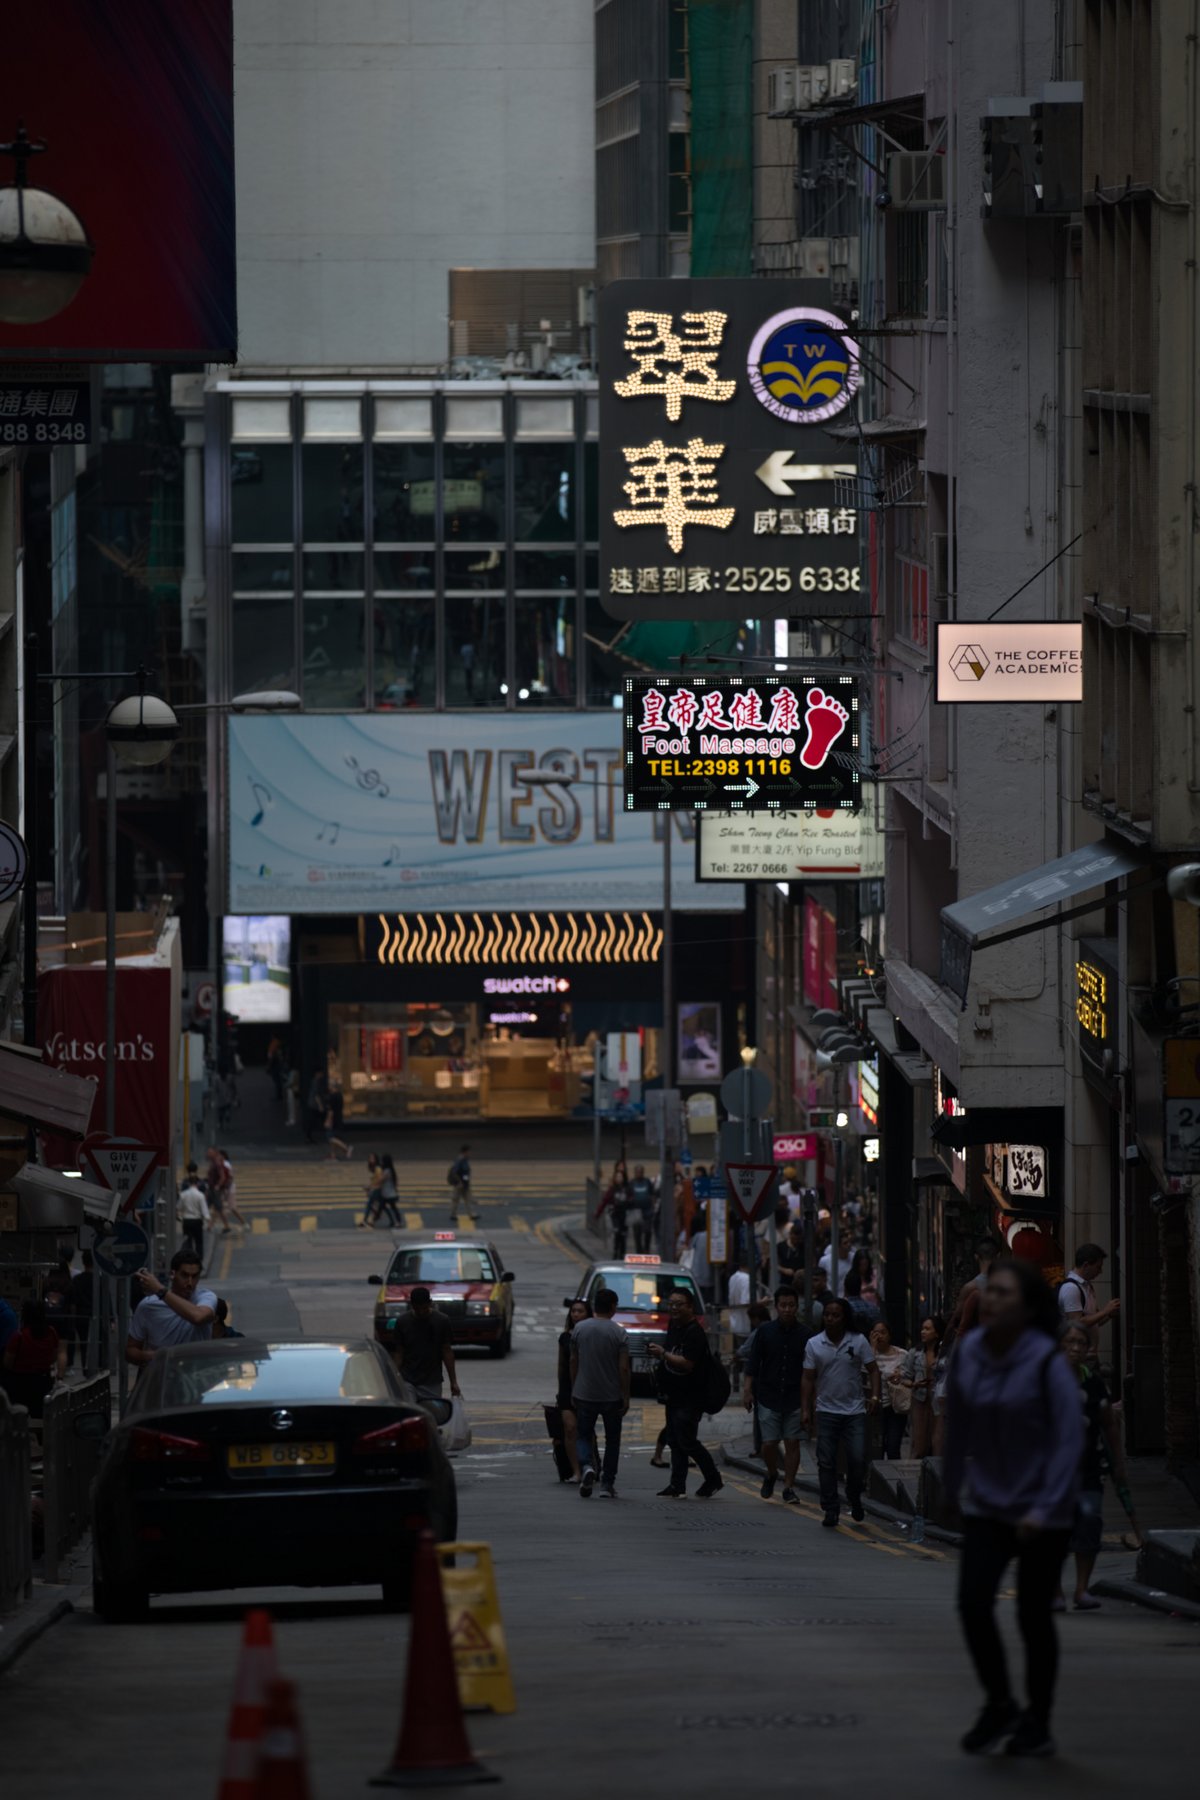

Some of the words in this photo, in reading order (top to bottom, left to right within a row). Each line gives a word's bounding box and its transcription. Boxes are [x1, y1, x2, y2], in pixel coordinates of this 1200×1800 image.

[783, 343, 827, 359] TW
[0, 422, 29, 441] 88
[35, 422, 86, 441] 8348
[613, 310, 737, 554] 翠華
[994, 651, 1021, 660] THE
[994, 661, 1082, 674] ACADEMÏC
[637, 686, 800, 736] 皇帝足健康
[641, 735, 691, 756] Foot
[700, 734, 796, 758] Massage
[744, 758, 792, 776] 1116
[428, 748, 624, 844] WEST
[796, 845, 814, 857] Yip
[815, 845, 842, 857] Fung
[711, 863, 730, 873] Tel:
[733, 863, 759, 873] 2267
[762, 863, 788, 873] 0666
[483, 975, 557, 994] swatch
[110, 1152, 137, 1161] GIVE
[111, 1163, 137, 1172] WAY
